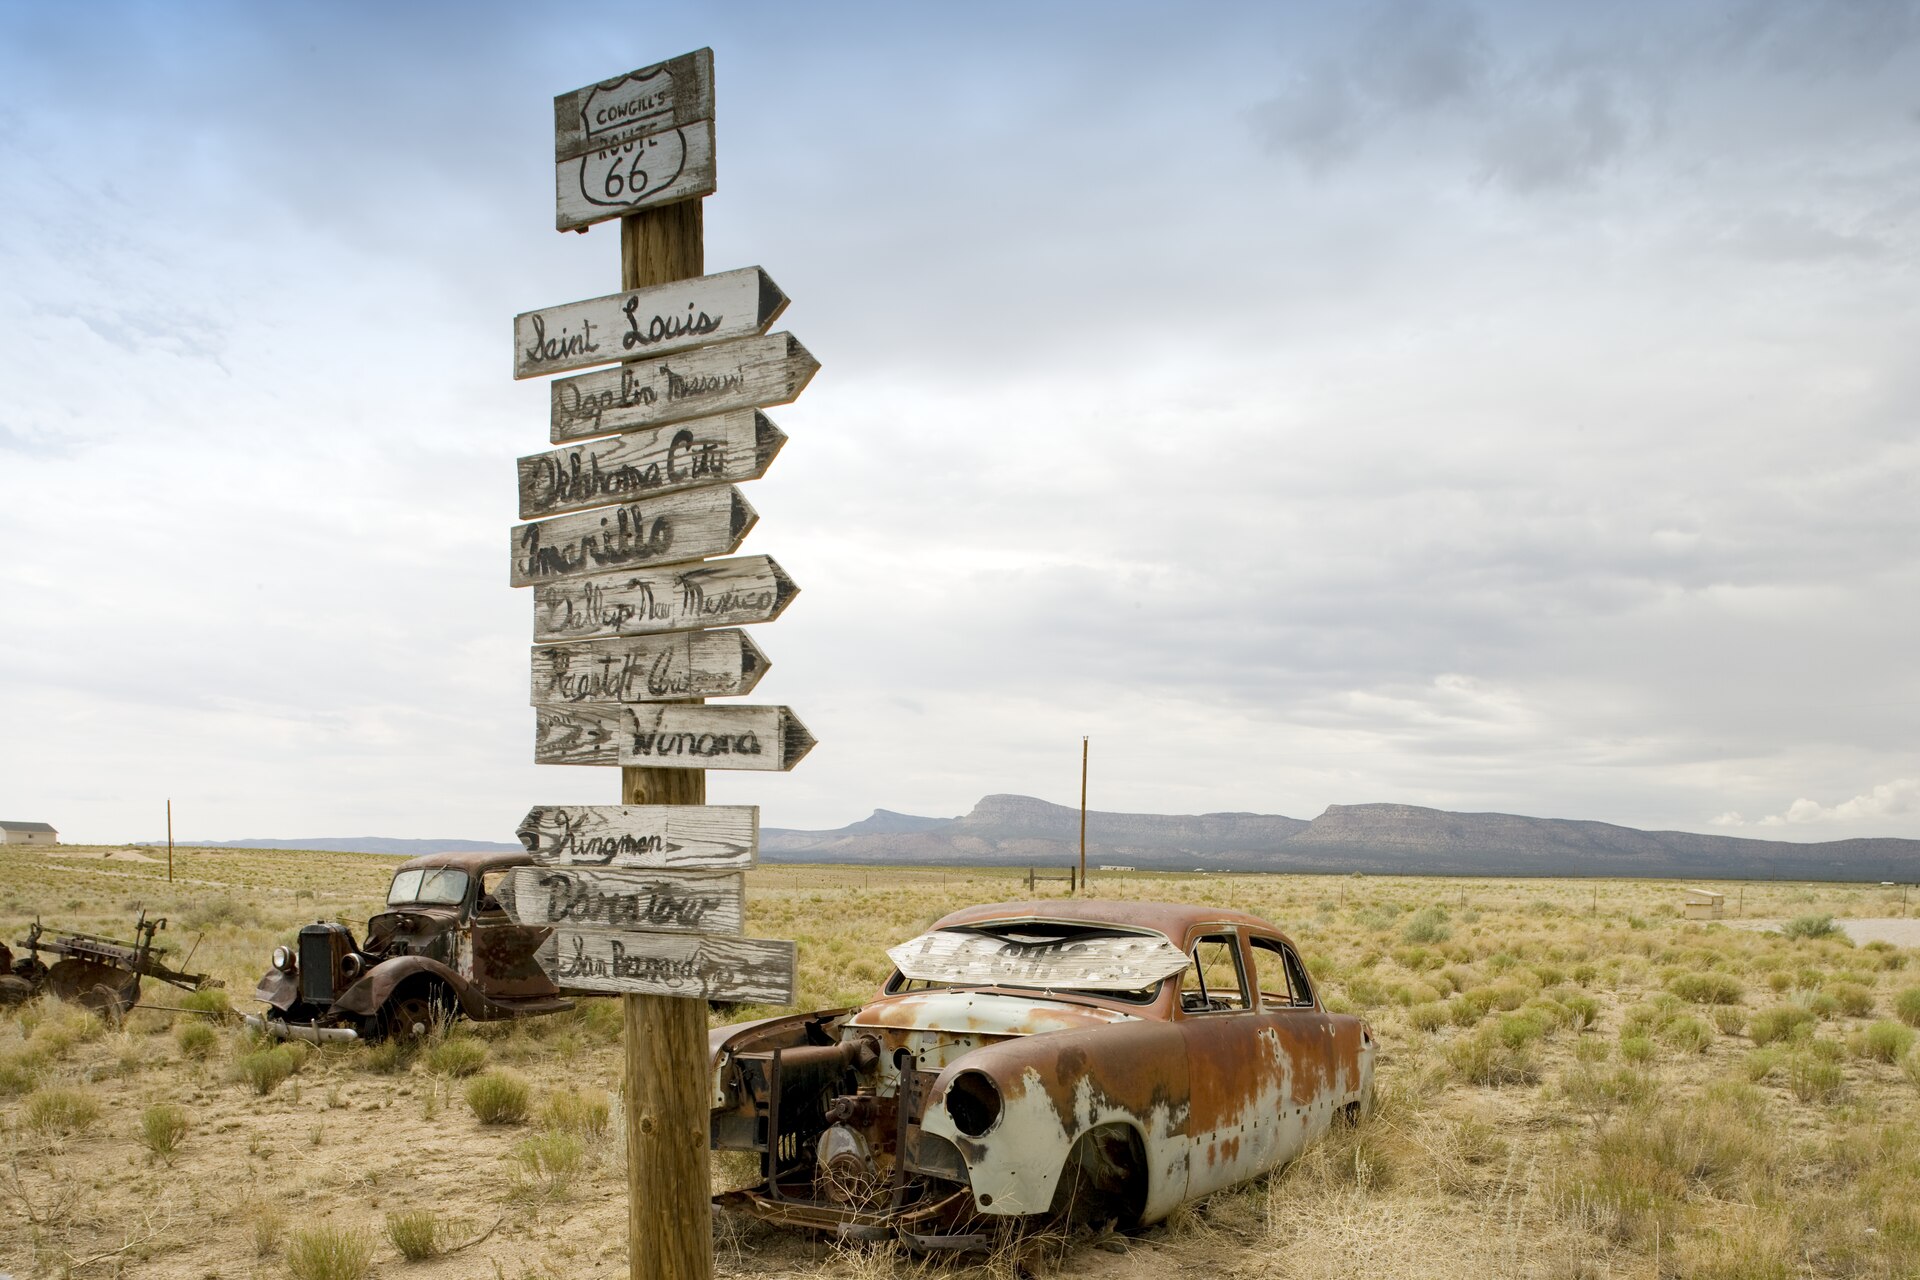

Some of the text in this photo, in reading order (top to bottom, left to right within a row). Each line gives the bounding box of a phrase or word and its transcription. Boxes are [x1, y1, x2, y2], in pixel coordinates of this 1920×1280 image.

[596, 91, 665, 125] COWGILL'S
[598, 122, 658, 160] ROUTE
[604, 150, 648, 197] 66
[526, 295, 722, 362] Saint Louis
